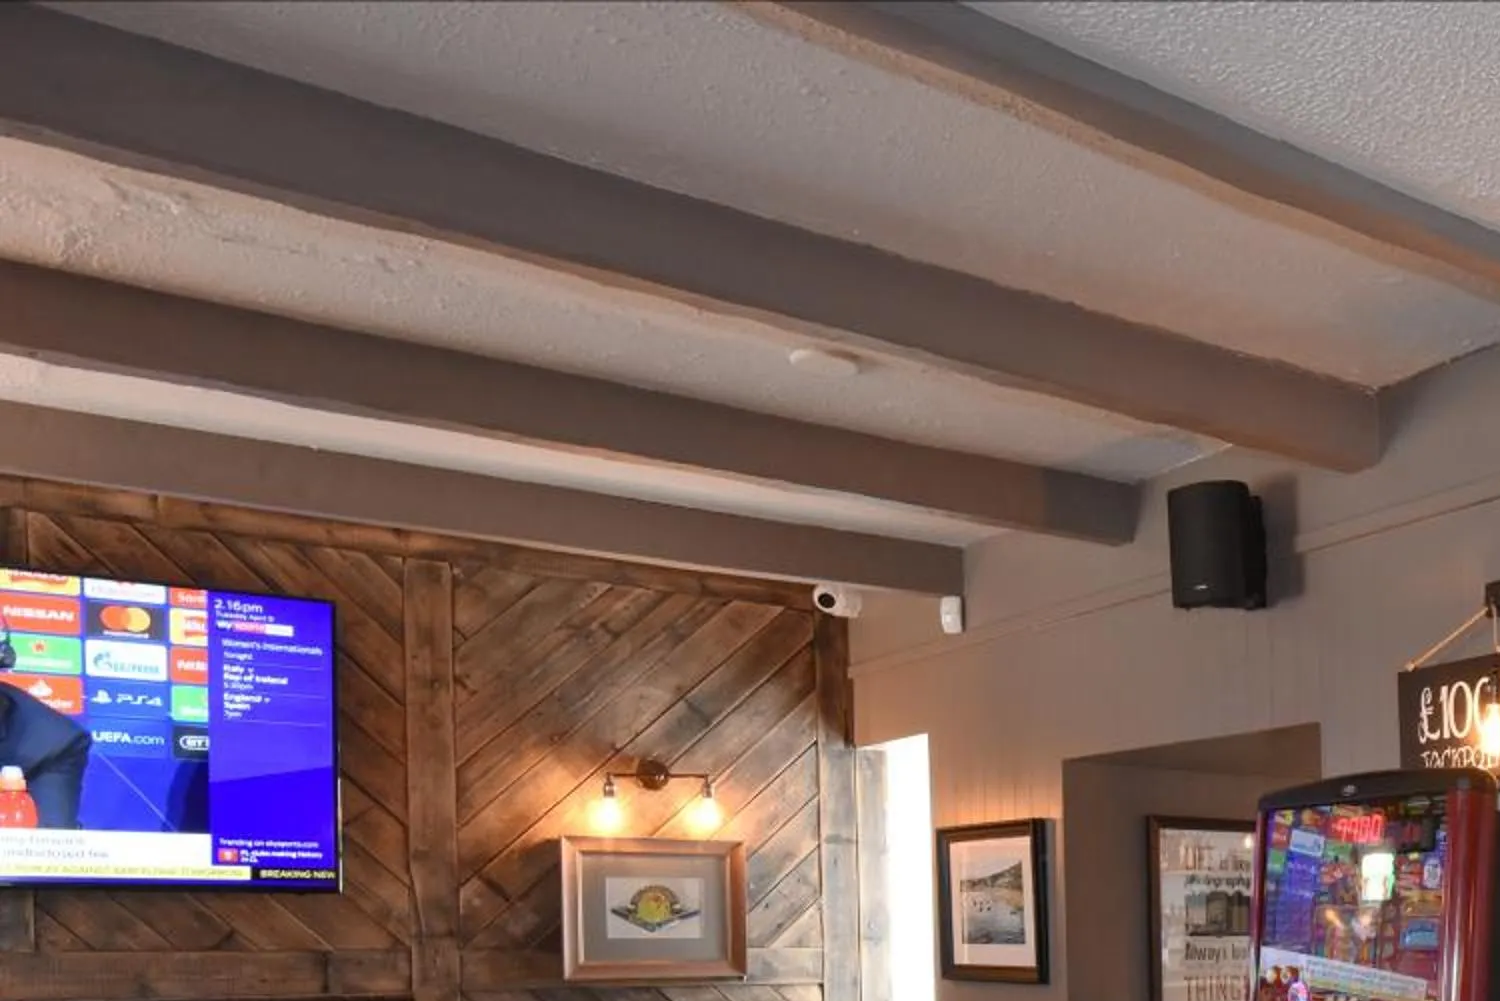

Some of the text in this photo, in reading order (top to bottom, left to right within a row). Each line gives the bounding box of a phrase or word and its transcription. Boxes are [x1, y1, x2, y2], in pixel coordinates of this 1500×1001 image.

[3, 605, 74, 622] NISSAN
[116, 693, 164, 706] PS4
[92, 730, 165, 746] UEFA.com
[260, 869, 311, 879] BREAKING
